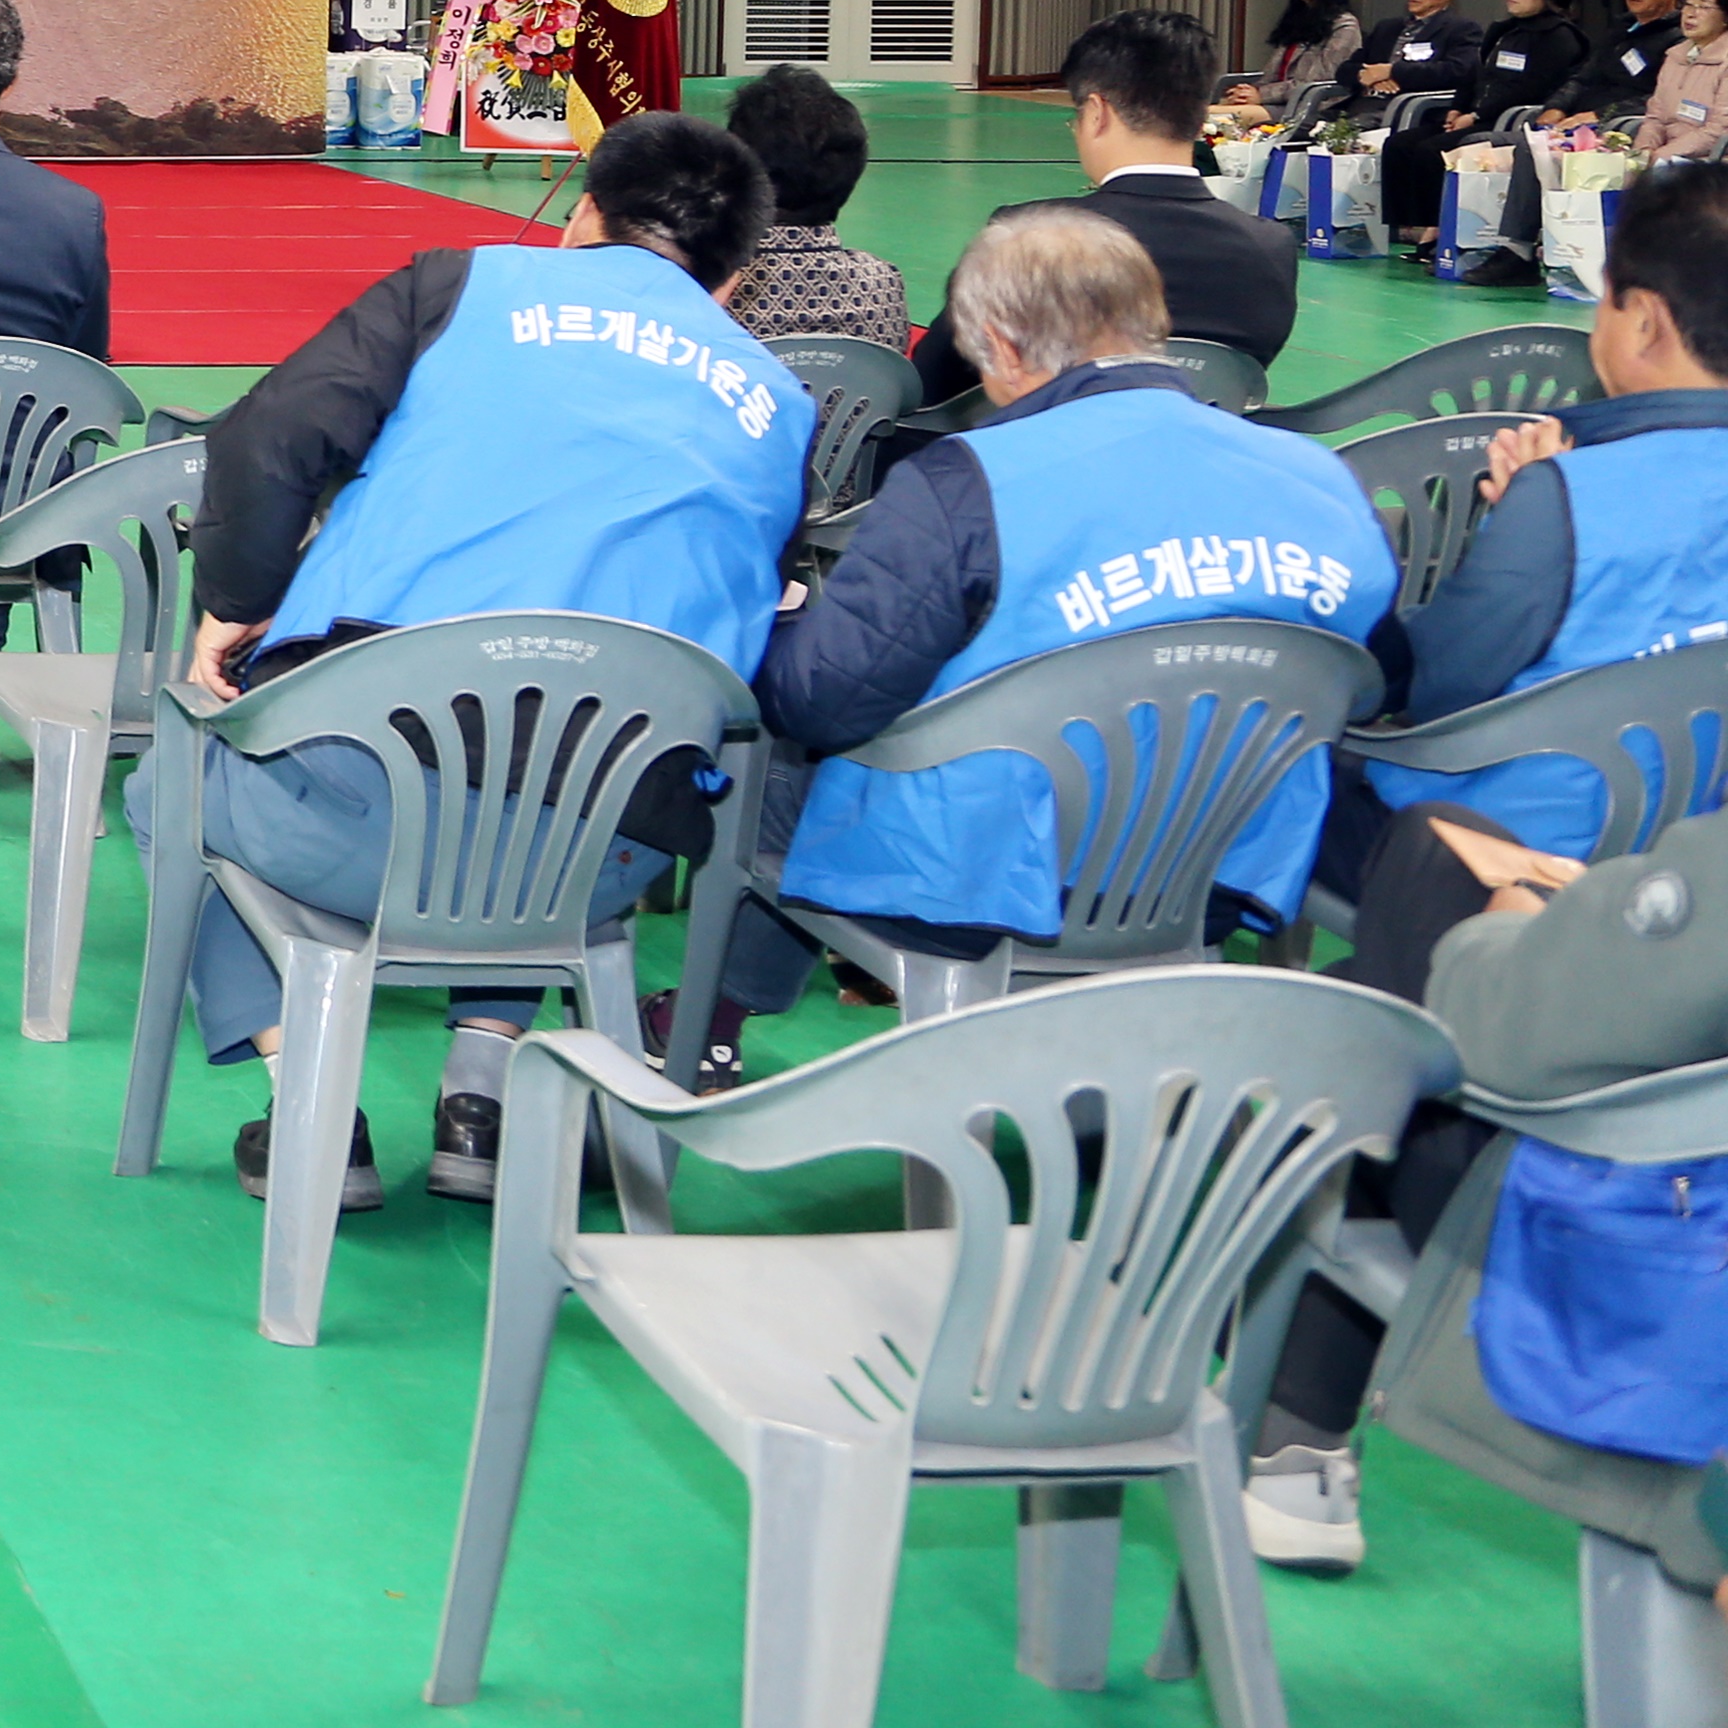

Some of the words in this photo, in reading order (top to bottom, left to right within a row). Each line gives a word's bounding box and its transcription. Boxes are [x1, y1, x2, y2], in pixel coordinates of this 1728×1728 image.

[439, 5, 472, 70] 이정희
[510, 303, 779, 440] 바르게살기운동
[1055, 535, 1352, 633] 바르게살기운동
